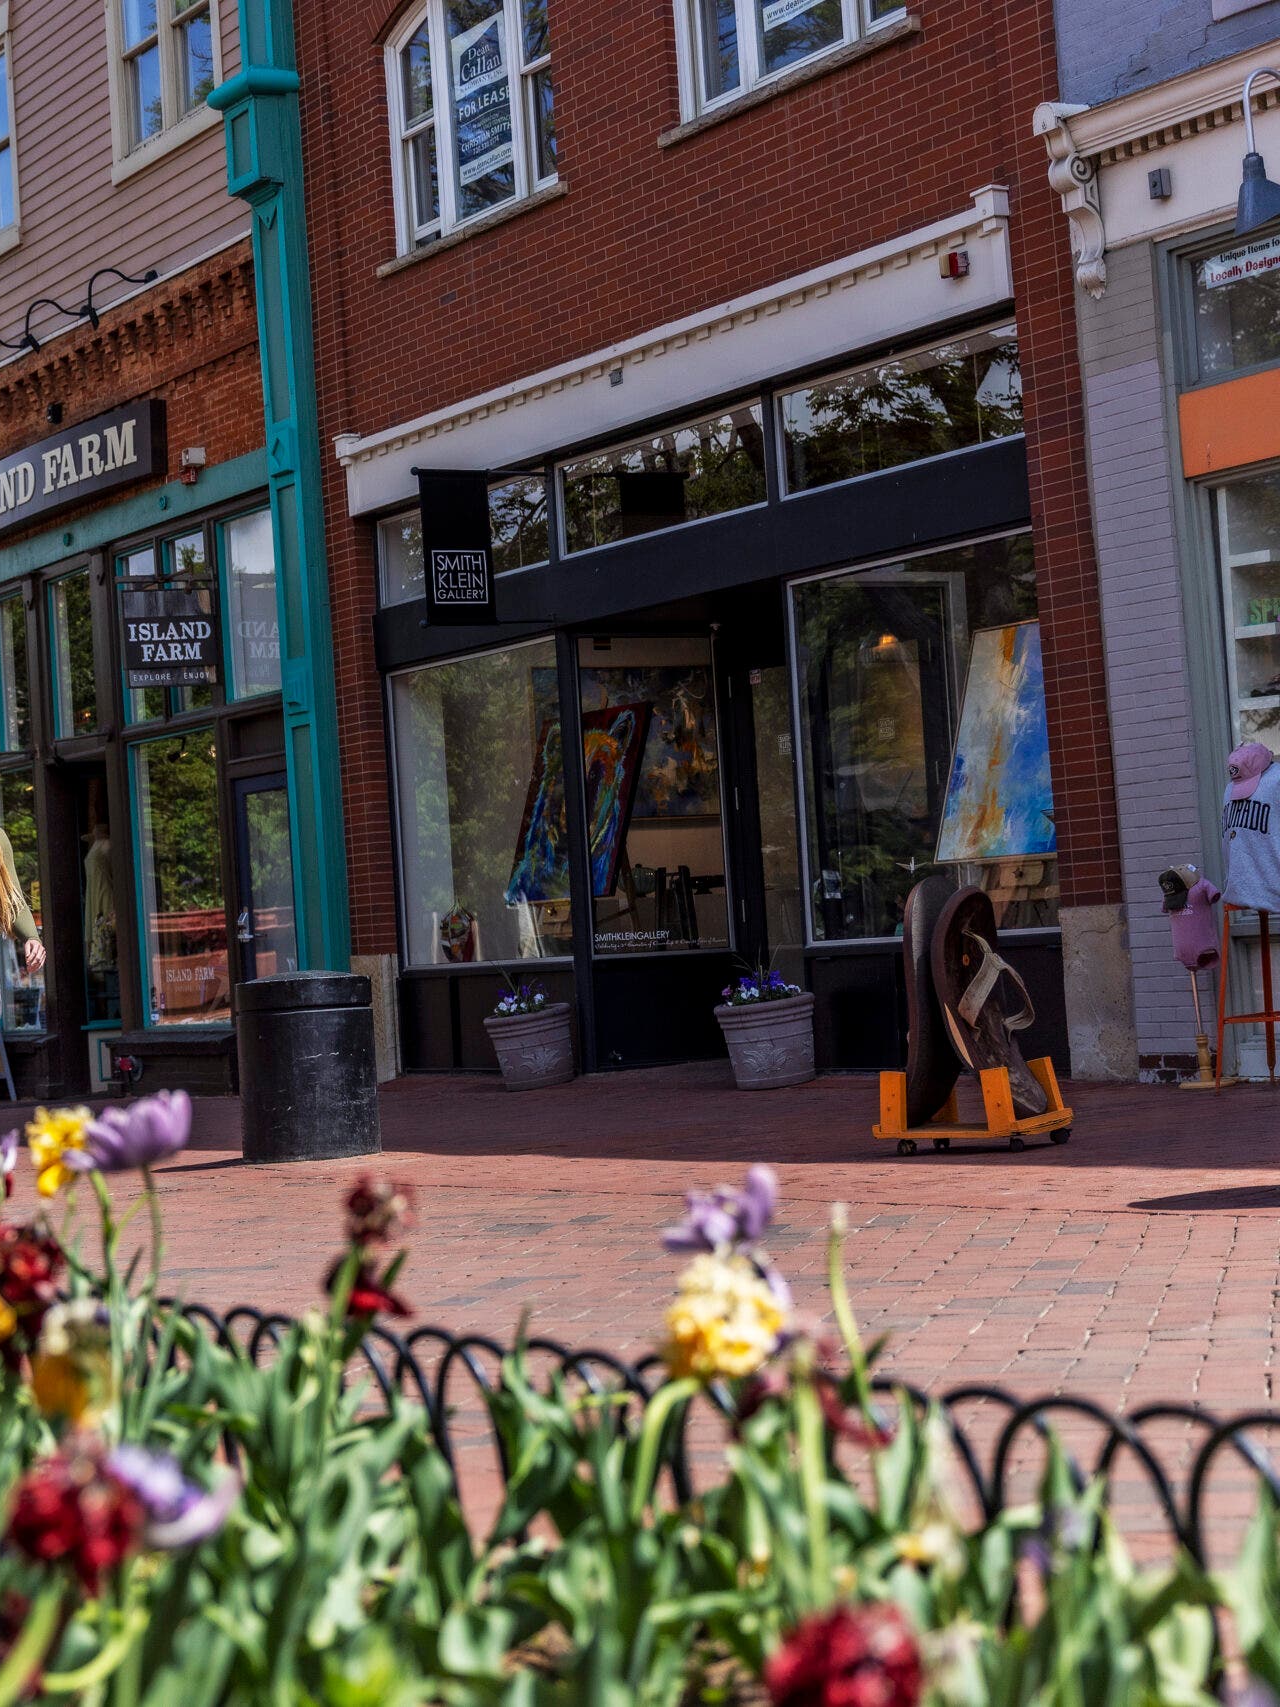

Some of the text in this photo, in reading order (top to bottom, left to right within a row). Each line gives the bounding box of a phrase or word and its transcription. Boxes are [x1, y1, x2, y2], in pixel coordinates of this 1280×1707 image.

[468, 44, 490, 60] Dean
[461, 54, 501, 82] Callan
[458, 87, 510, 120] FOR LEASE
[461, 121, 512, 152] CHRISTIAN SMITH
[1220, 250, 1246, 263] Unique
[1248, 242, 1270, 254] Items
[1210, 265, 1242, 283] Locally
[42, 419, 137, 495] FARM
[437, 555, 482, 571] SMITH
[438, 572, 484, 588] KLEIN
[438, 589, 485, 599] GALLERY
[128, 621, 211, 642] ISLAND
[141, 642, 202, 662] FARM
[133, 672, 211, 681] EXPLORE ENJOY
[594, 930, 670, 942] SMITHKLEINGALLERY
[165, 966, 215, 982] ISLAND FARM
